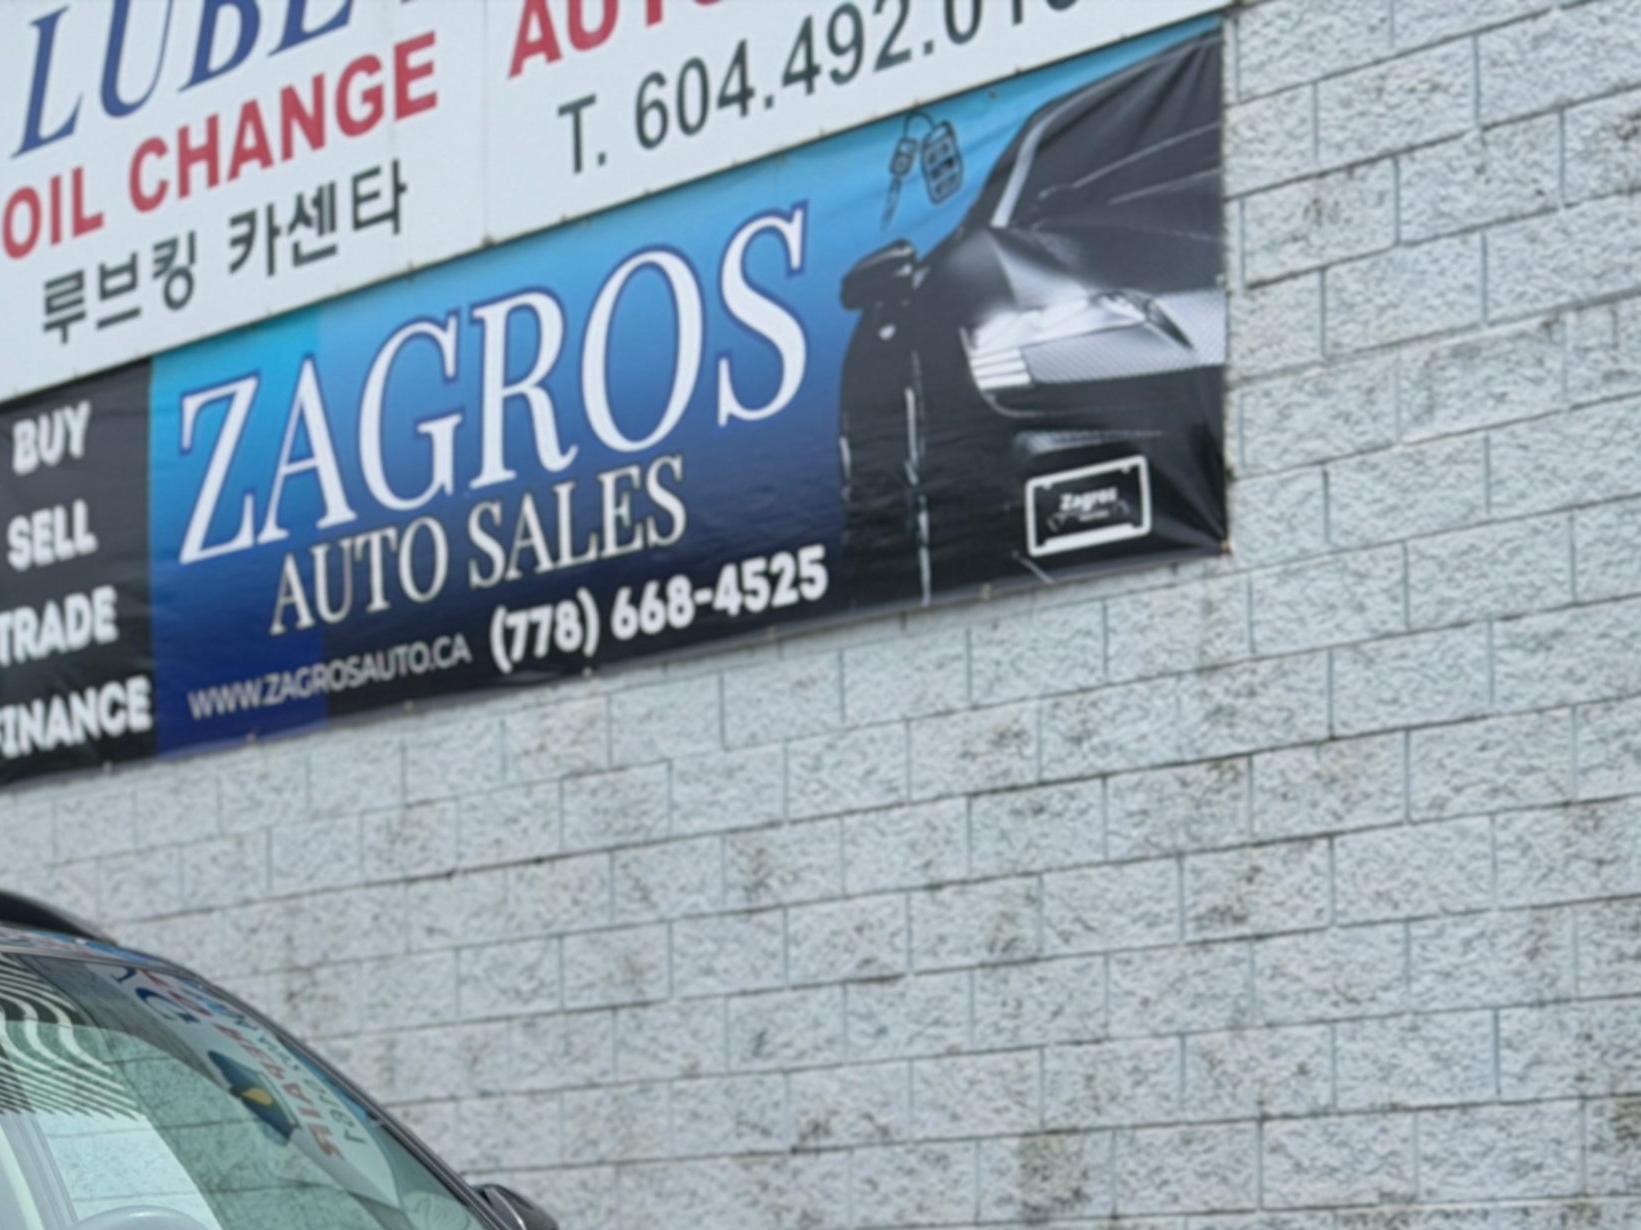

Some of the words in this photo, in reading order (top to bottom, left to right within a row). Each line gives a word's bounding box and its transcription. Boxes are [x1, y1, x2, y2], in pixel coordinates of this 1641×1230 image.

[2, 166, 104, 260] OIL
[129, 31, 438, 213] CHANGE
[558, 94, 607, 174] T.
[43, 231, 196, 344] 루브킹
[229, 159, 408, 277] 카센타
[12, 402, 91, 474] BUY
[178, 201, 810, 566] ZAGROS
[7, 500, 98, 571] SELL
[269, 515, 449, 636] AUTO
[468, 455, 688, 590] SALES
[490, 590, 600, 673] (778)
[611, 545, 830, 641] 668-4525
[189, 634, 472, 721] WWW.ZAGROSAUTO.CA
